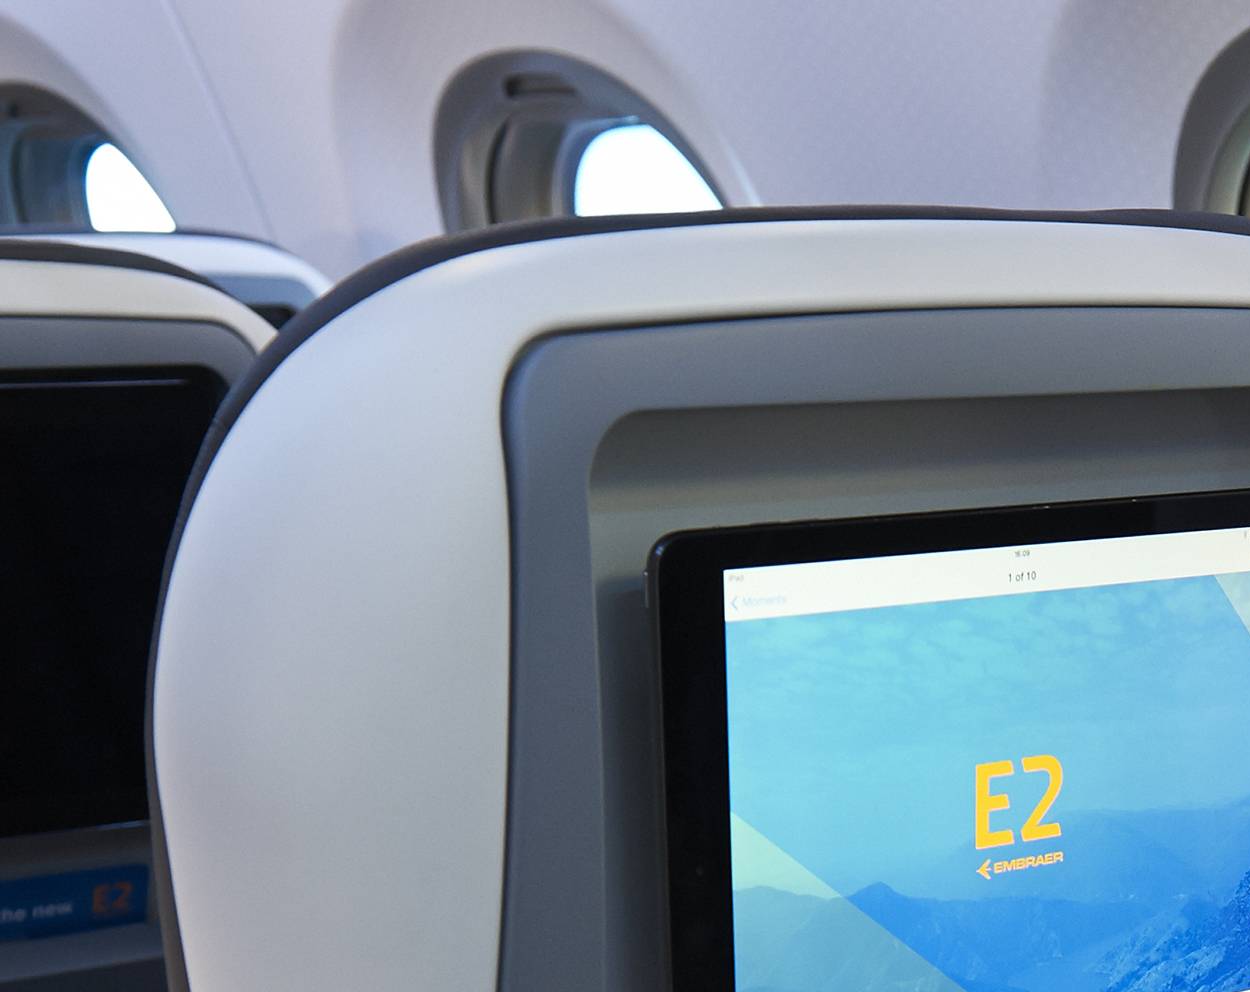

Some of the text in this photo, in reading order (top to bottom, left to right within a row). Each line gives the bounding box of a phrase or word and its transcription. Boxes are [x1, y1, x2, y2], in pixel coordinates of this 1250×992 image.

[1015, 572, 1024, 582] of
[1027, 570, 1037, 581] 10
[975, 753, 1063, 850] E2
[993, 851, 1064, 874] EMBRAER
[92, 881, 134, 913] E2
